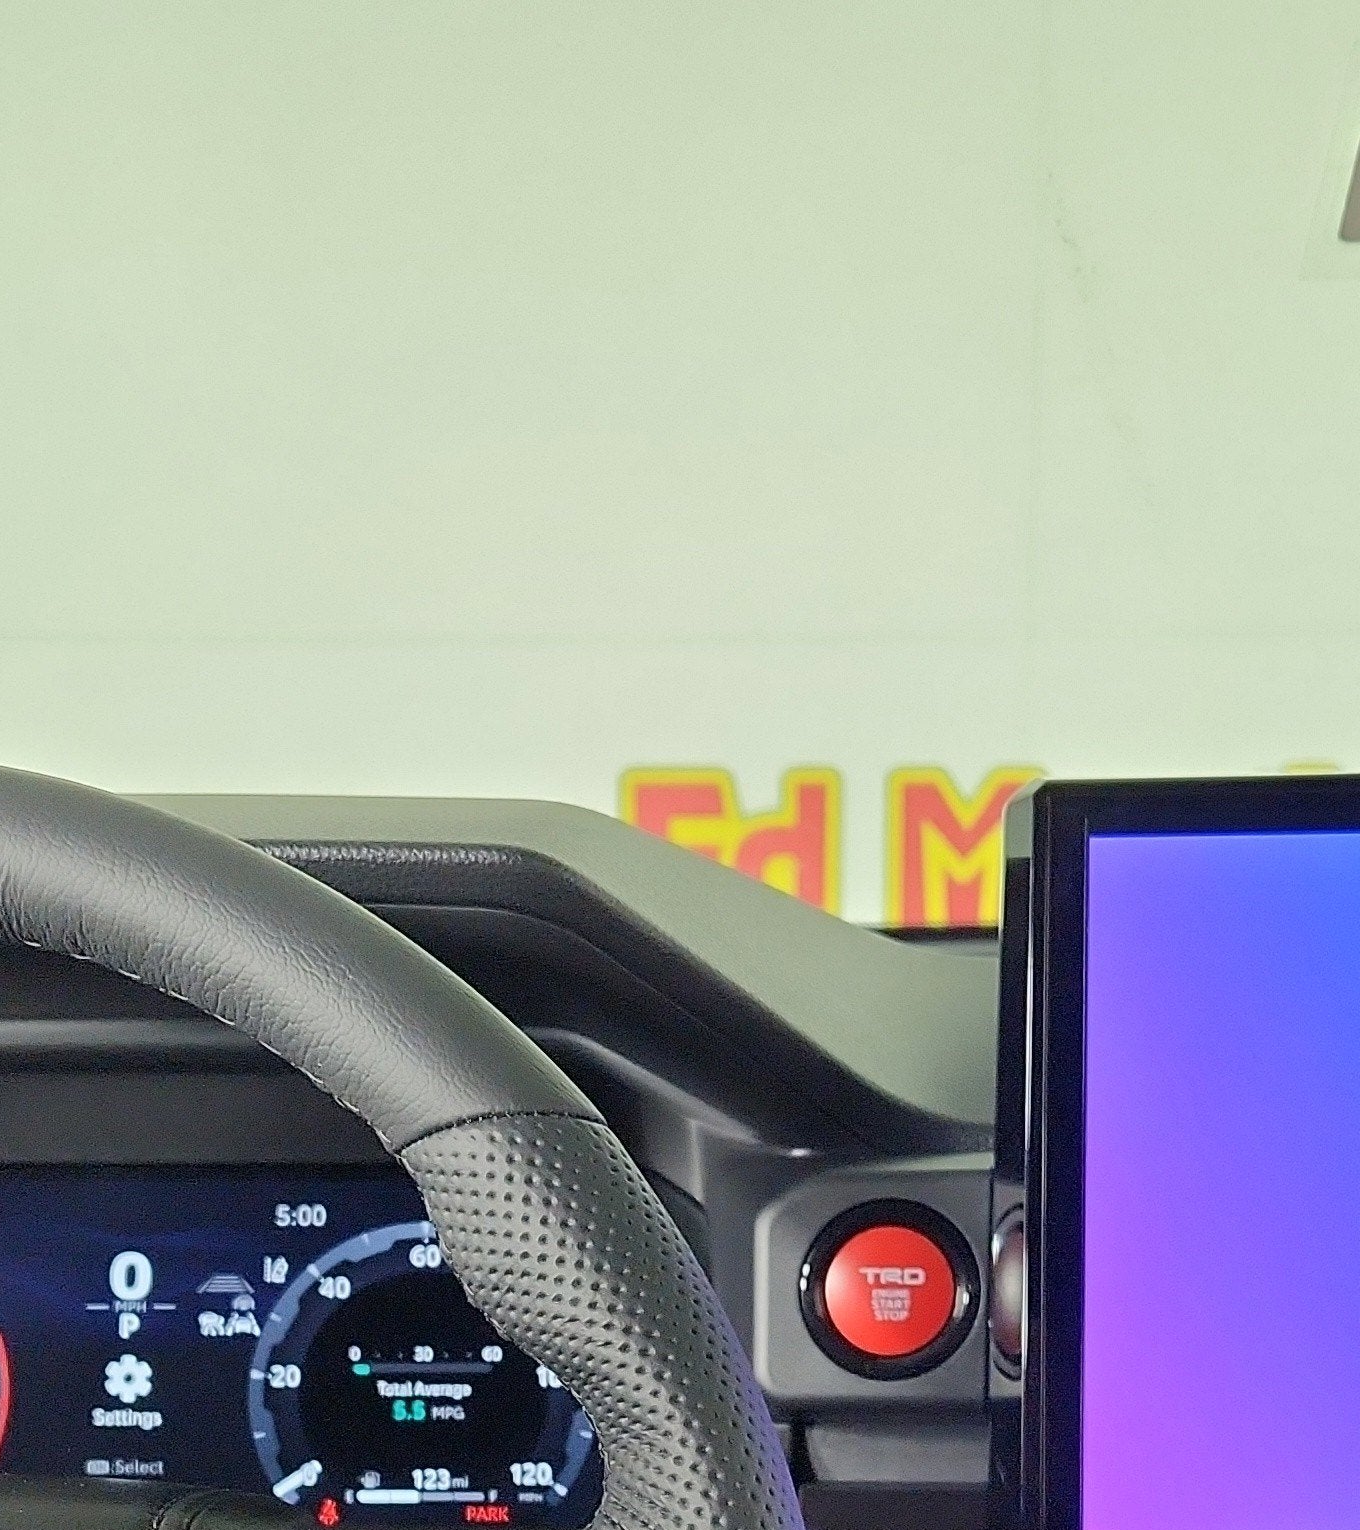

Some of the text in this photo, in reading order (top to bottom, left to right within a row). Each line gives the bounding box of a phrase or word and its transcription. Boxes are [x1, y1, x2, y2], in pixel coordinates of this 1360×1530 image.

[274, 1203, 327, 1228] 5:00
[409, 1243, 442, 1268] 60
[109, 1250, 154, 1301] 0
[317, 1275, 351, 1300] 40
[859, 1267, 926, 1286] TRD
[118, 1312, 140, 1339] P
[268, 1364, 302, 1388] 20
[376, 1379, 473, 1400] Total Average
[91, 1407, 163, 1430] Settings
[431, 1405, 465, 1421] MPG
[412, 1467, 451, 1491] 123
[509, 1461, 554, 1487] 120
[465, 1505, 509, 1522] PARK
